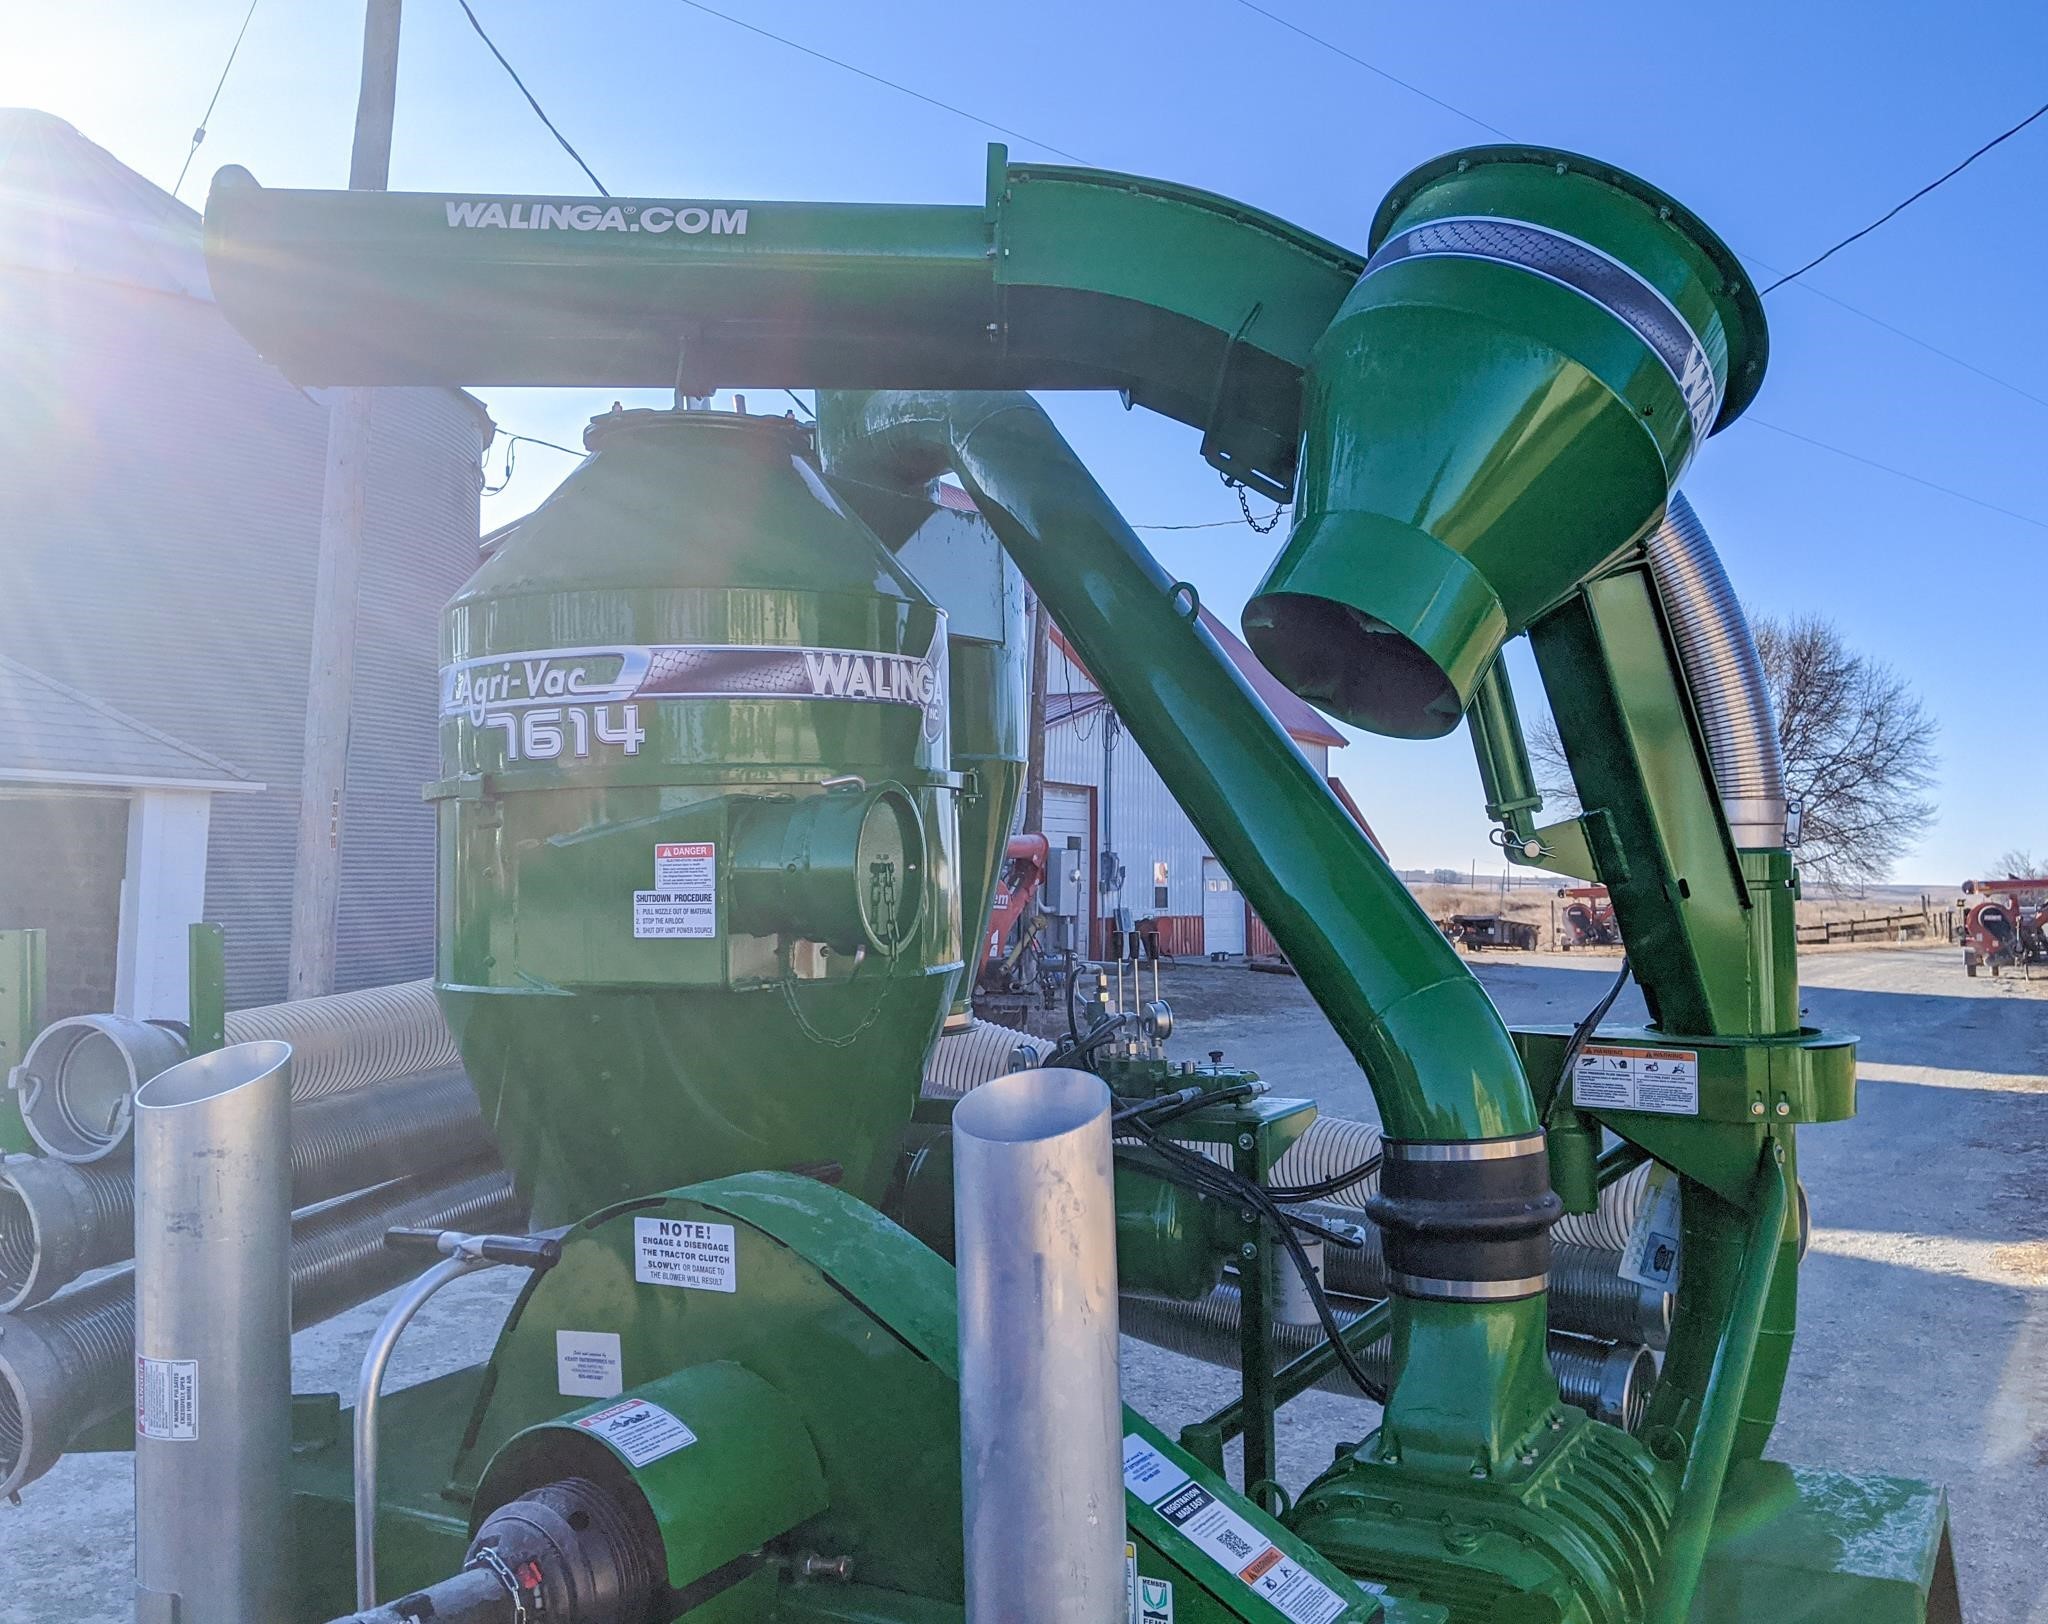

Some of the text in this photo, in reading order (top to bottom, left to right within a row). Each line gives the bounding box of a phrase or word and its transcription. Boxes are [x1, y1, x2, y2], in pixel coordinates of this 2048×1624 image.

[802, 651, 944, 706] WALINGA
[458, 659, 586, 727] Agri-Vac
[486, 704, 645, 761] 7614
[673, 846, 707, 856] DANGER
[636, 893, 712, 903] SHUTDOWN PROCEDURE
[660, 1222, 711, 1240] NOTE!
[643, 1236, 674, 1247] ENGAGE
[684, 1240, 729, 1252] DISENGAGE
[642, 1248, 730, 1264] THE TRACTOR CLUTCH
[648, 1260, 680, 1271] SLOWLY!
[692, 1265, 716, 1274] DAMAGE
[717, 1267, 725, 1275] TO
[650, 1271, 661, 1279] THE
[663, 1273, 685, 1281] BLOWER
[687, 1275, 700, 1284] WILL
[701, 1276, 723, 1286] RESULT
[1163, 1487, 1201, 1515] REGISTRATION
[1175, 1497, 1205, 1520] MADE EASY
[1143, 1579, 1167, 1588] MEMBER
